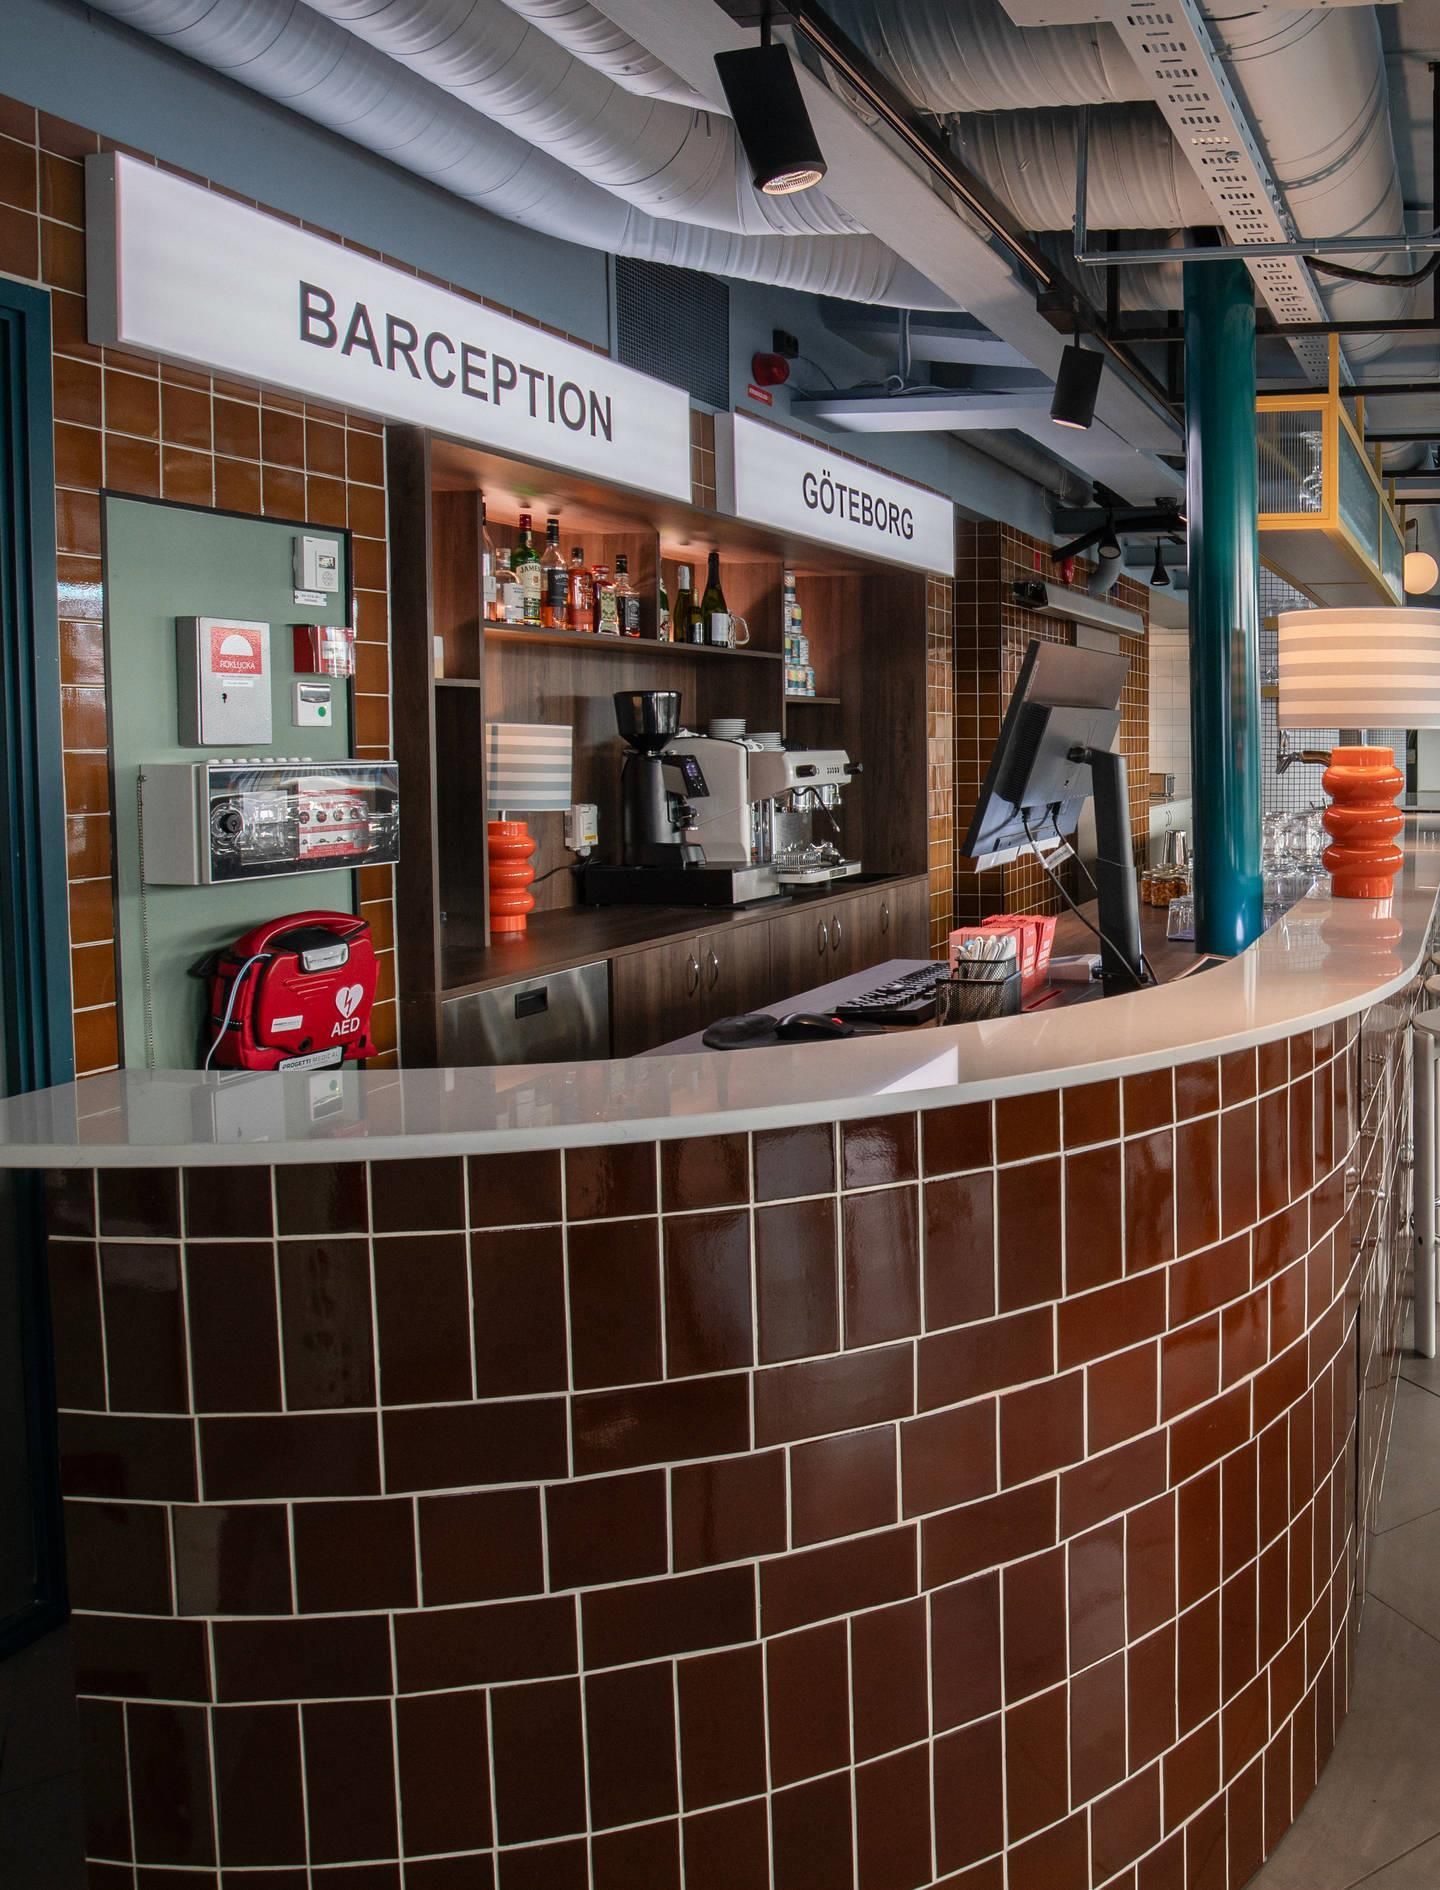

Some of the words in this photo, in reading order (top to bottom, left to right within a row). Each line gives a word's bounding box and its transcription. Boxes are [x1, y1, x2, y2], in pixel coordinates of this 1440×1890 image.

[299, 279, 613, 442] BARCEPTION
[802, 469, 914, 540] GÖTEBORG
[330, 1016, 360, 1038] AED
[281, 1058, 312, 1070] PROGETTI
[312, 1050, 339, 1063] MEDICAL
